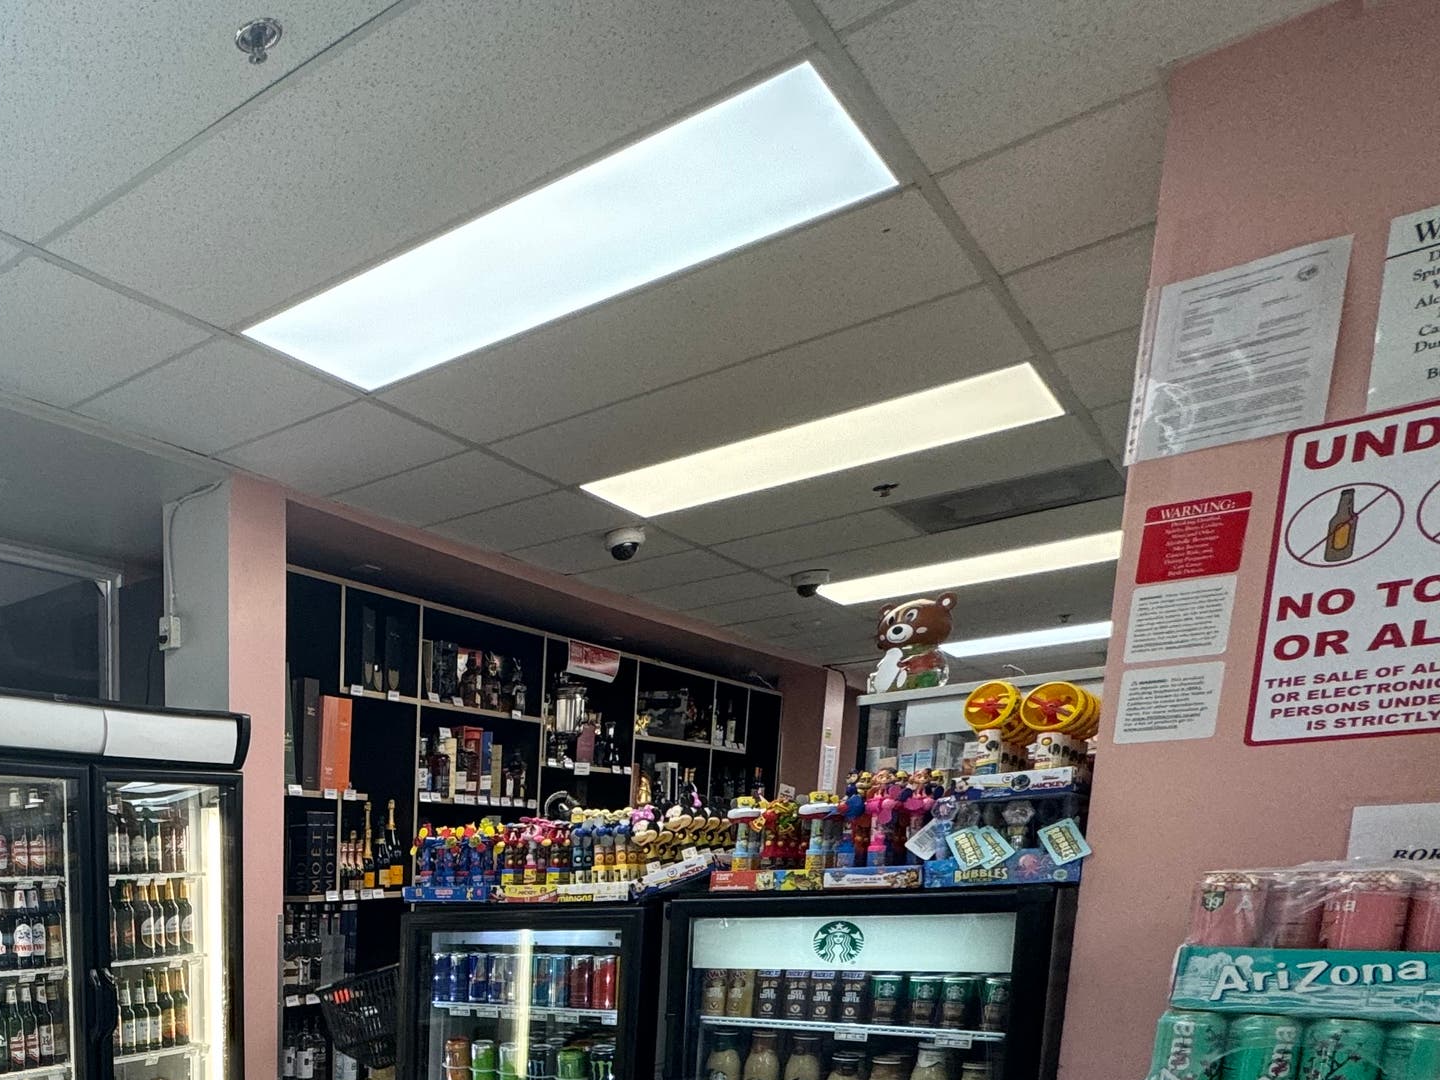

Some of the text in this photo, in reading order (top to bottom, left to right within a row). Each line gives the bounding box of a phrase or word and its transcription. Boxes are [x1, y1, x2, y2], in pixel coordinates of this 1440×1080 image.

[1160, 499, 1236, 520] WARNING:
[1276, 588, 1356, 622] NO
[1273, 629, 1350, 661] OR
[1264, 675, 1306, 689] THE
[1312, 669, 1368, 685] SALE
[1375, 665, 1406, 678] OF
[1271, 691, 1301, 704] OR
[1269, 700, 1371, 719] PERSONS
[1306, 710, 1440, 731] IS STRICTLY
[954, 867, 1008, 884] BUBBLES
[1209, 959, 1429, 1002] AriZona
